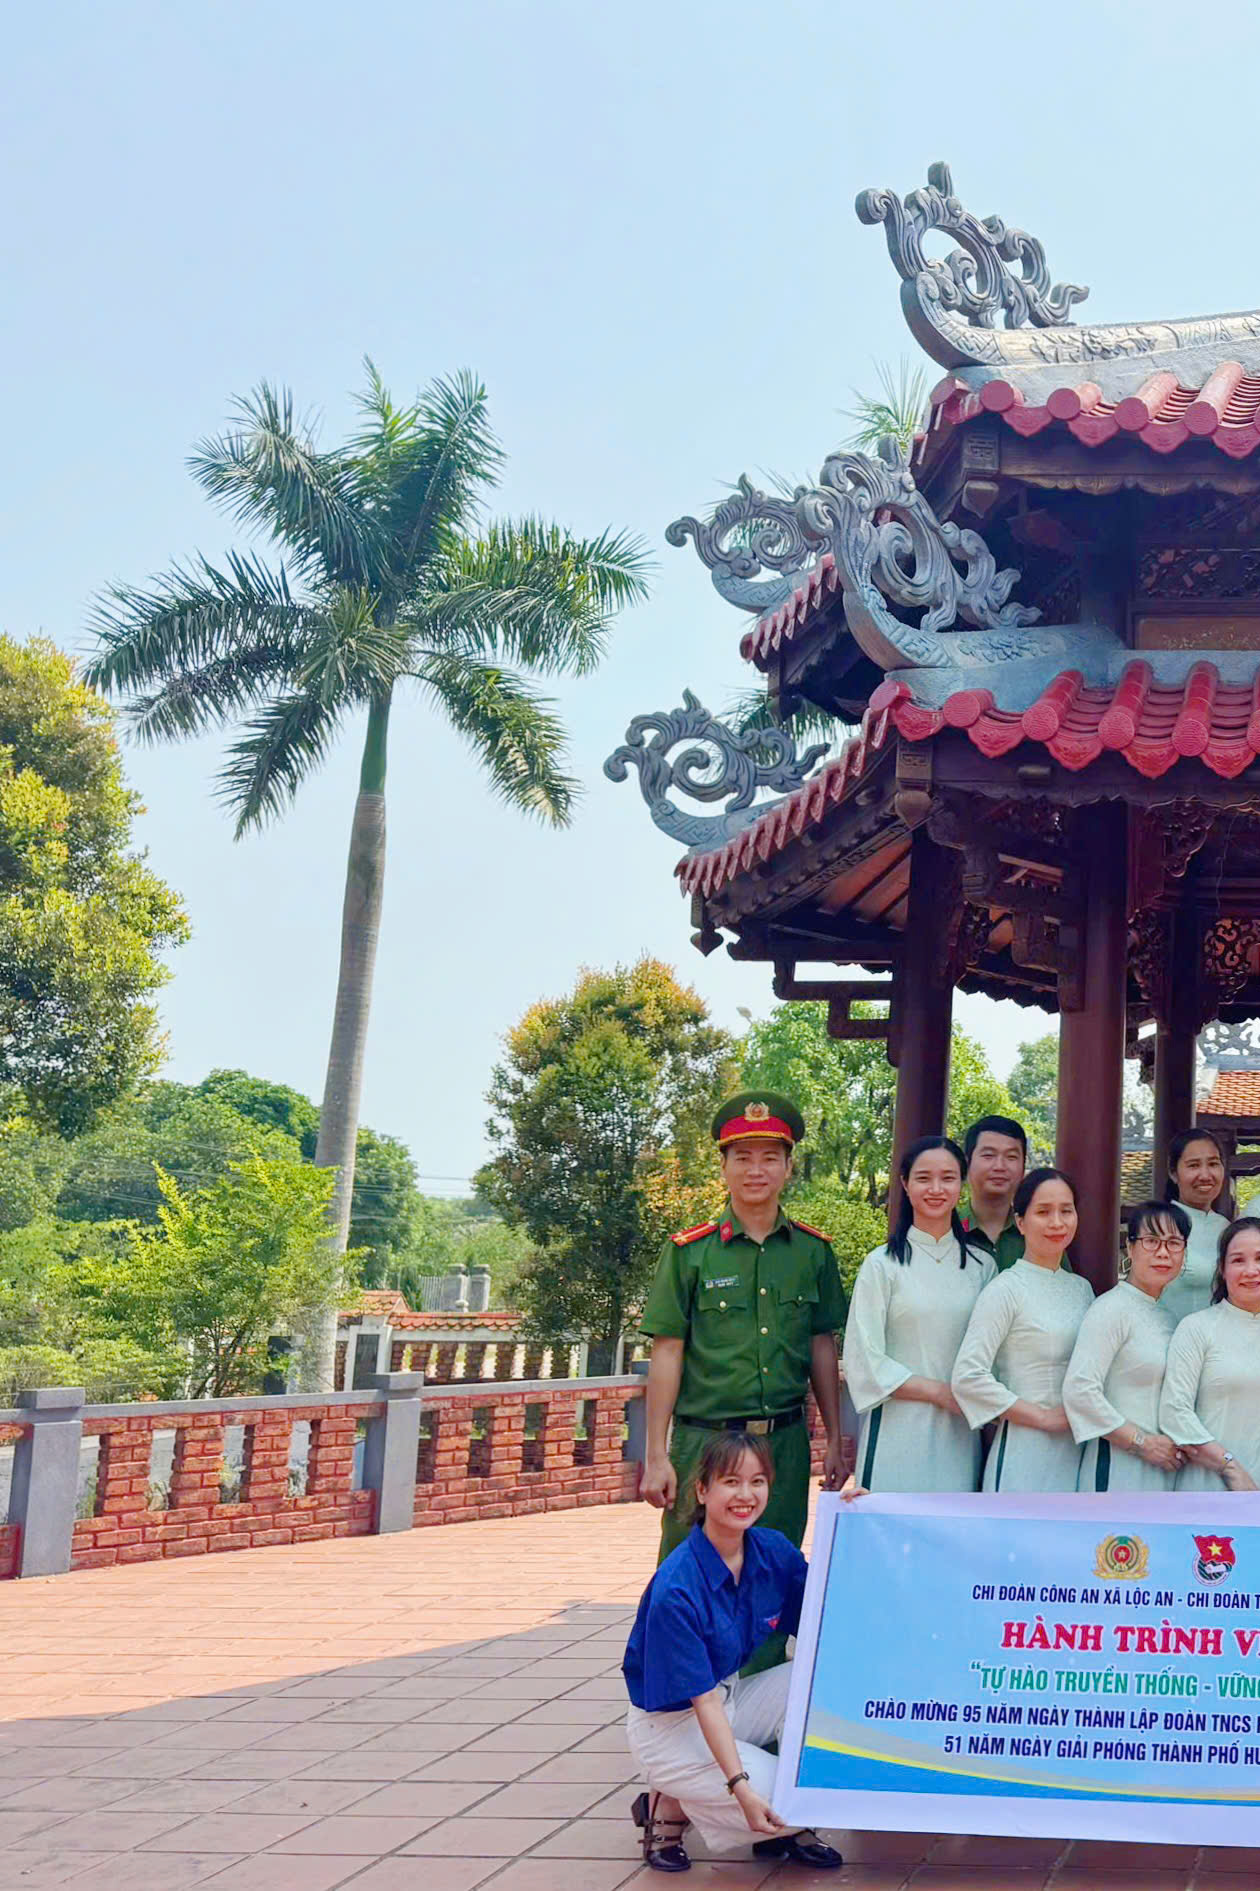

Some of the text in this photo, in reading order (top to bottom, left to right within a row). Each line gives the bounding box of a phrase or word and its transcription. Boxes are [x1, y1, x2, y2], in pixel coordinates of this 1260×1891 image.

[972, 1585, 994, 1600] CHI
[999, 1583, 1036, 1602] ĐOÀN
[1040, 1585, 1077, 1603] CÔNG
[1080, 1588, 1099, 1604] AN
[1104, 1587, 1122, 1605] XÃ
[1126, 1588, 1150, 1608] LỘC
[1154, 1591, 1173, 1606] AN
[1187, 1592, 1209, 1607] CHI
[1213, 1590, 1250, 1609] ĐOÀN
[1001, 1615, 1103, 1651] HÀNH
[1114, 1619, 1223, 1656] TRÌNH
[1009, 1665, 1048, 1690] HÀO
[1055, 1665, 1129, 1694] TRUYỀN
[1134, 1666, 1198, 1696] THỐNG
[864, 1698, 907, 1720] CHÀO
[911, 1699, 958, 1722] MỪNG
[962, 1705, 982, 1723] 95
[986, 1702, 1022, 1725] NĂM
[1027, 1705, 1070, 1726] NGÀY
[1074, 1706, 1125, 1729] THÀNH
[1130, 1708, 1159, 1733] LẬP
[1164, 1709, 1206, 1732] ĐOÀN
[1211, 1714, 1251, 1733] TNCS
[944, 1736, 961, 1753] 51
[968, 1733, 1005, 1755] NĂM
[1010, 1736, 1052, 1757] NGÀY
[1056, 1735, 1088, 1759] GIẢI
[1093, 1738, 1146, 1761] PHÓNG
[1151, 1740, 1203, 1763] THÀNH
[1208, 1740, 1240, 1764] PHỐ
